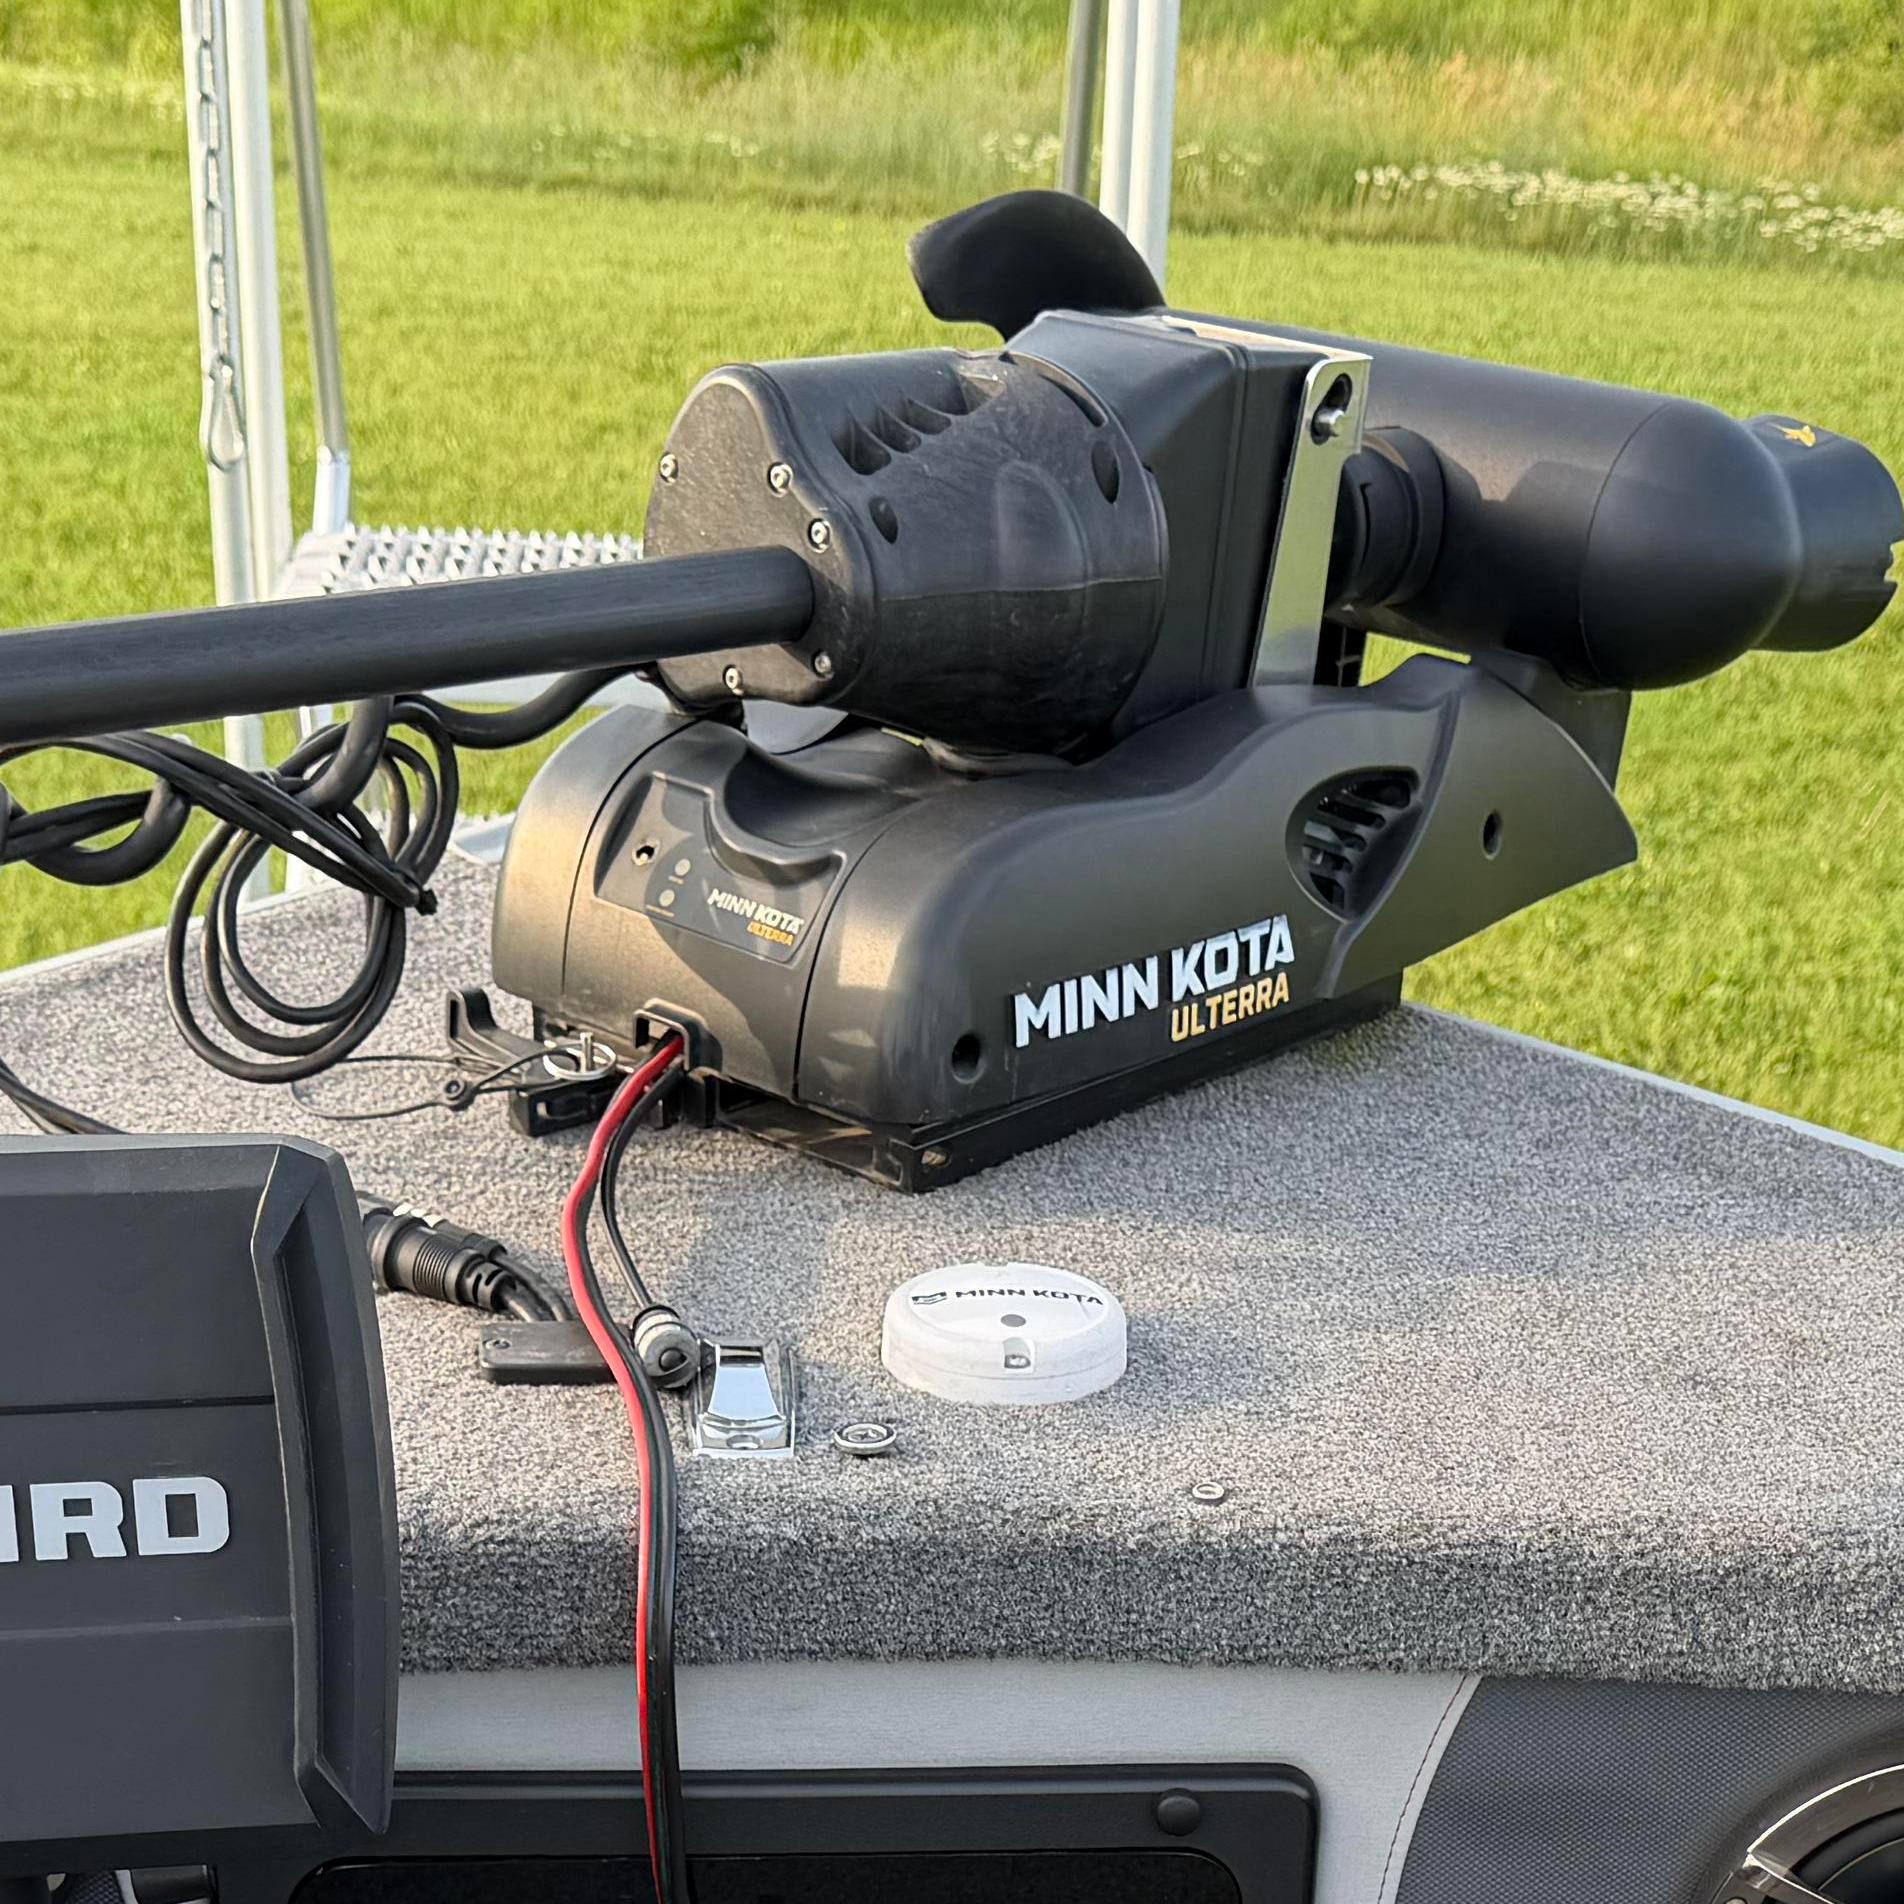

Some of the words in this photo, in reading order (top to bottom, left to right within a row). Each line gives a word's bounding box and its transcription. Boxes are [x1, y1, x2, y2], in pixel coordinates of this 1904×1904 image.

[707, 888, 757, 919] MINN
[754, 902, 803, 934] KOTA
[1014, 955, 1160, 1049] MINN
[1171, 913, 1296, 1002] KOTA
[1169, 971, 1290, 1043] ULTERRA
[955, 1288, 1026, 1299] MINN
[1032, 1288, 1104, 1306] KOTA
